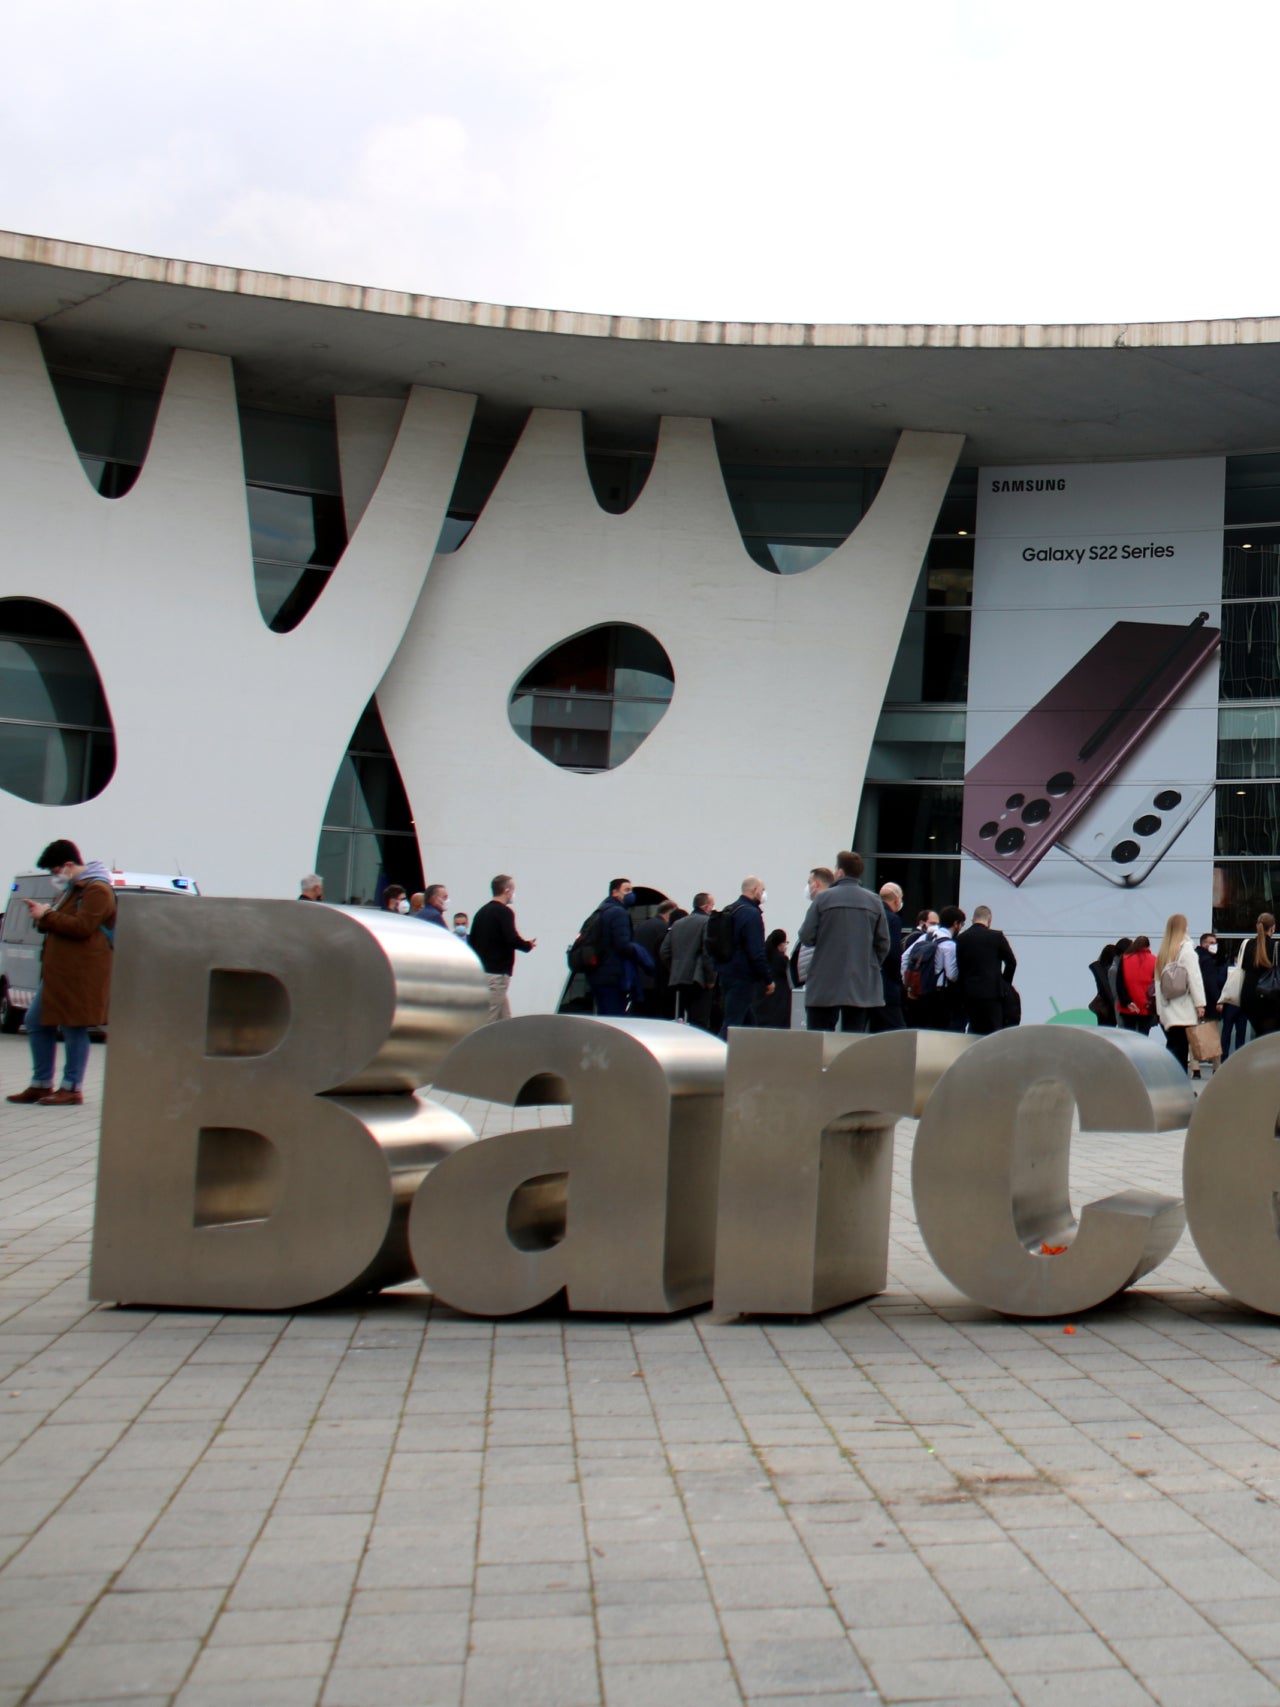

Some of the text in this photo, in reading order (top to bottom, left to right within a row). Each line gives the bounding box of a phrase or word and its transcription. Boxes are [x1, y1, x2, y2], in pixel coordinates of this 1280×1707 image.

[991, 478, 1066, 493] SAMSUNG
[1022, 543, 1175, 565] Galaxy S22 Series
